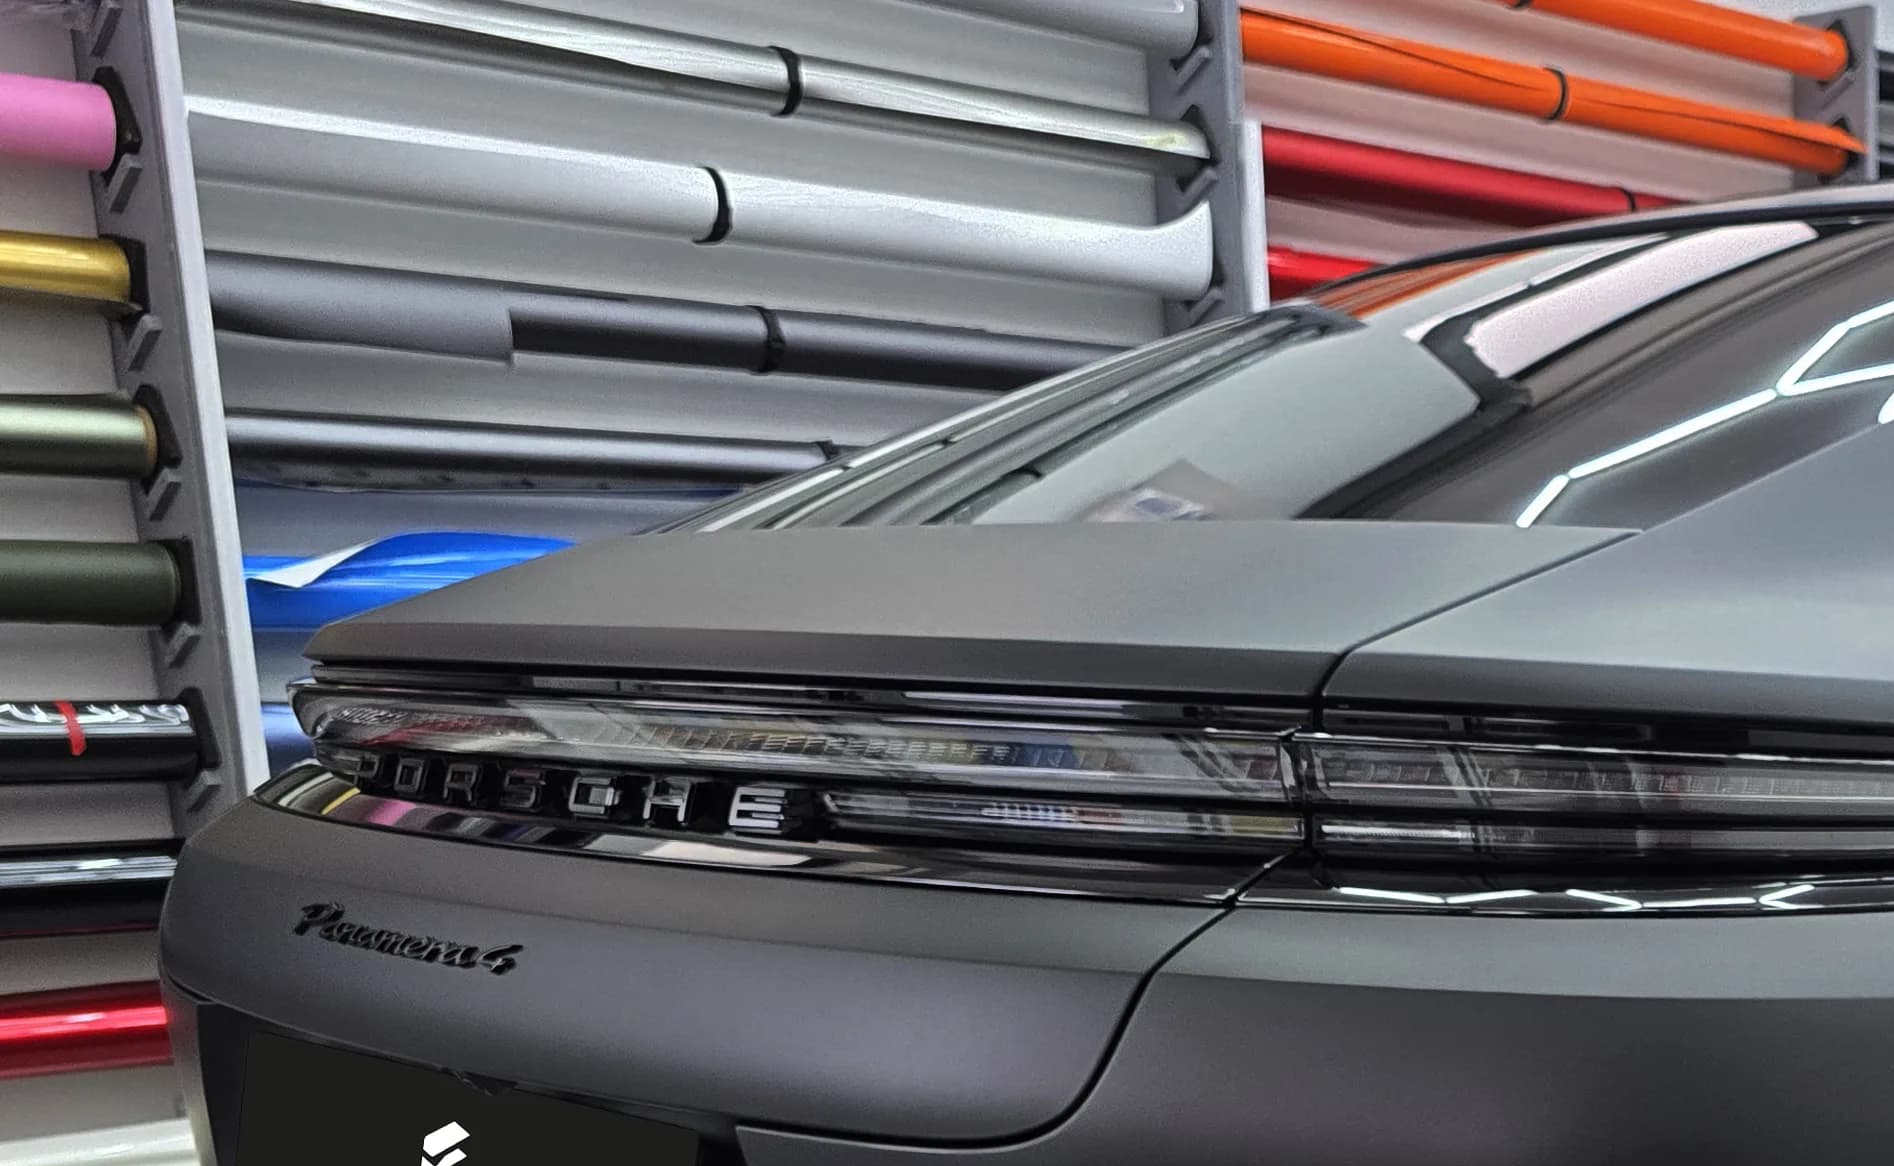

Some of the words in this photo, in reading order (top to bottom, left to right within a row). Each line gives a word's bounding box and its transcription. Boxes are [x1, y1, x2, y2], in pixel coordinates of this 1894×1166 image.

[348, 752, 786, 835] PORSCHE
[293, 902, 479, 968] Panamera
[478, 945, 524, 975] 4
